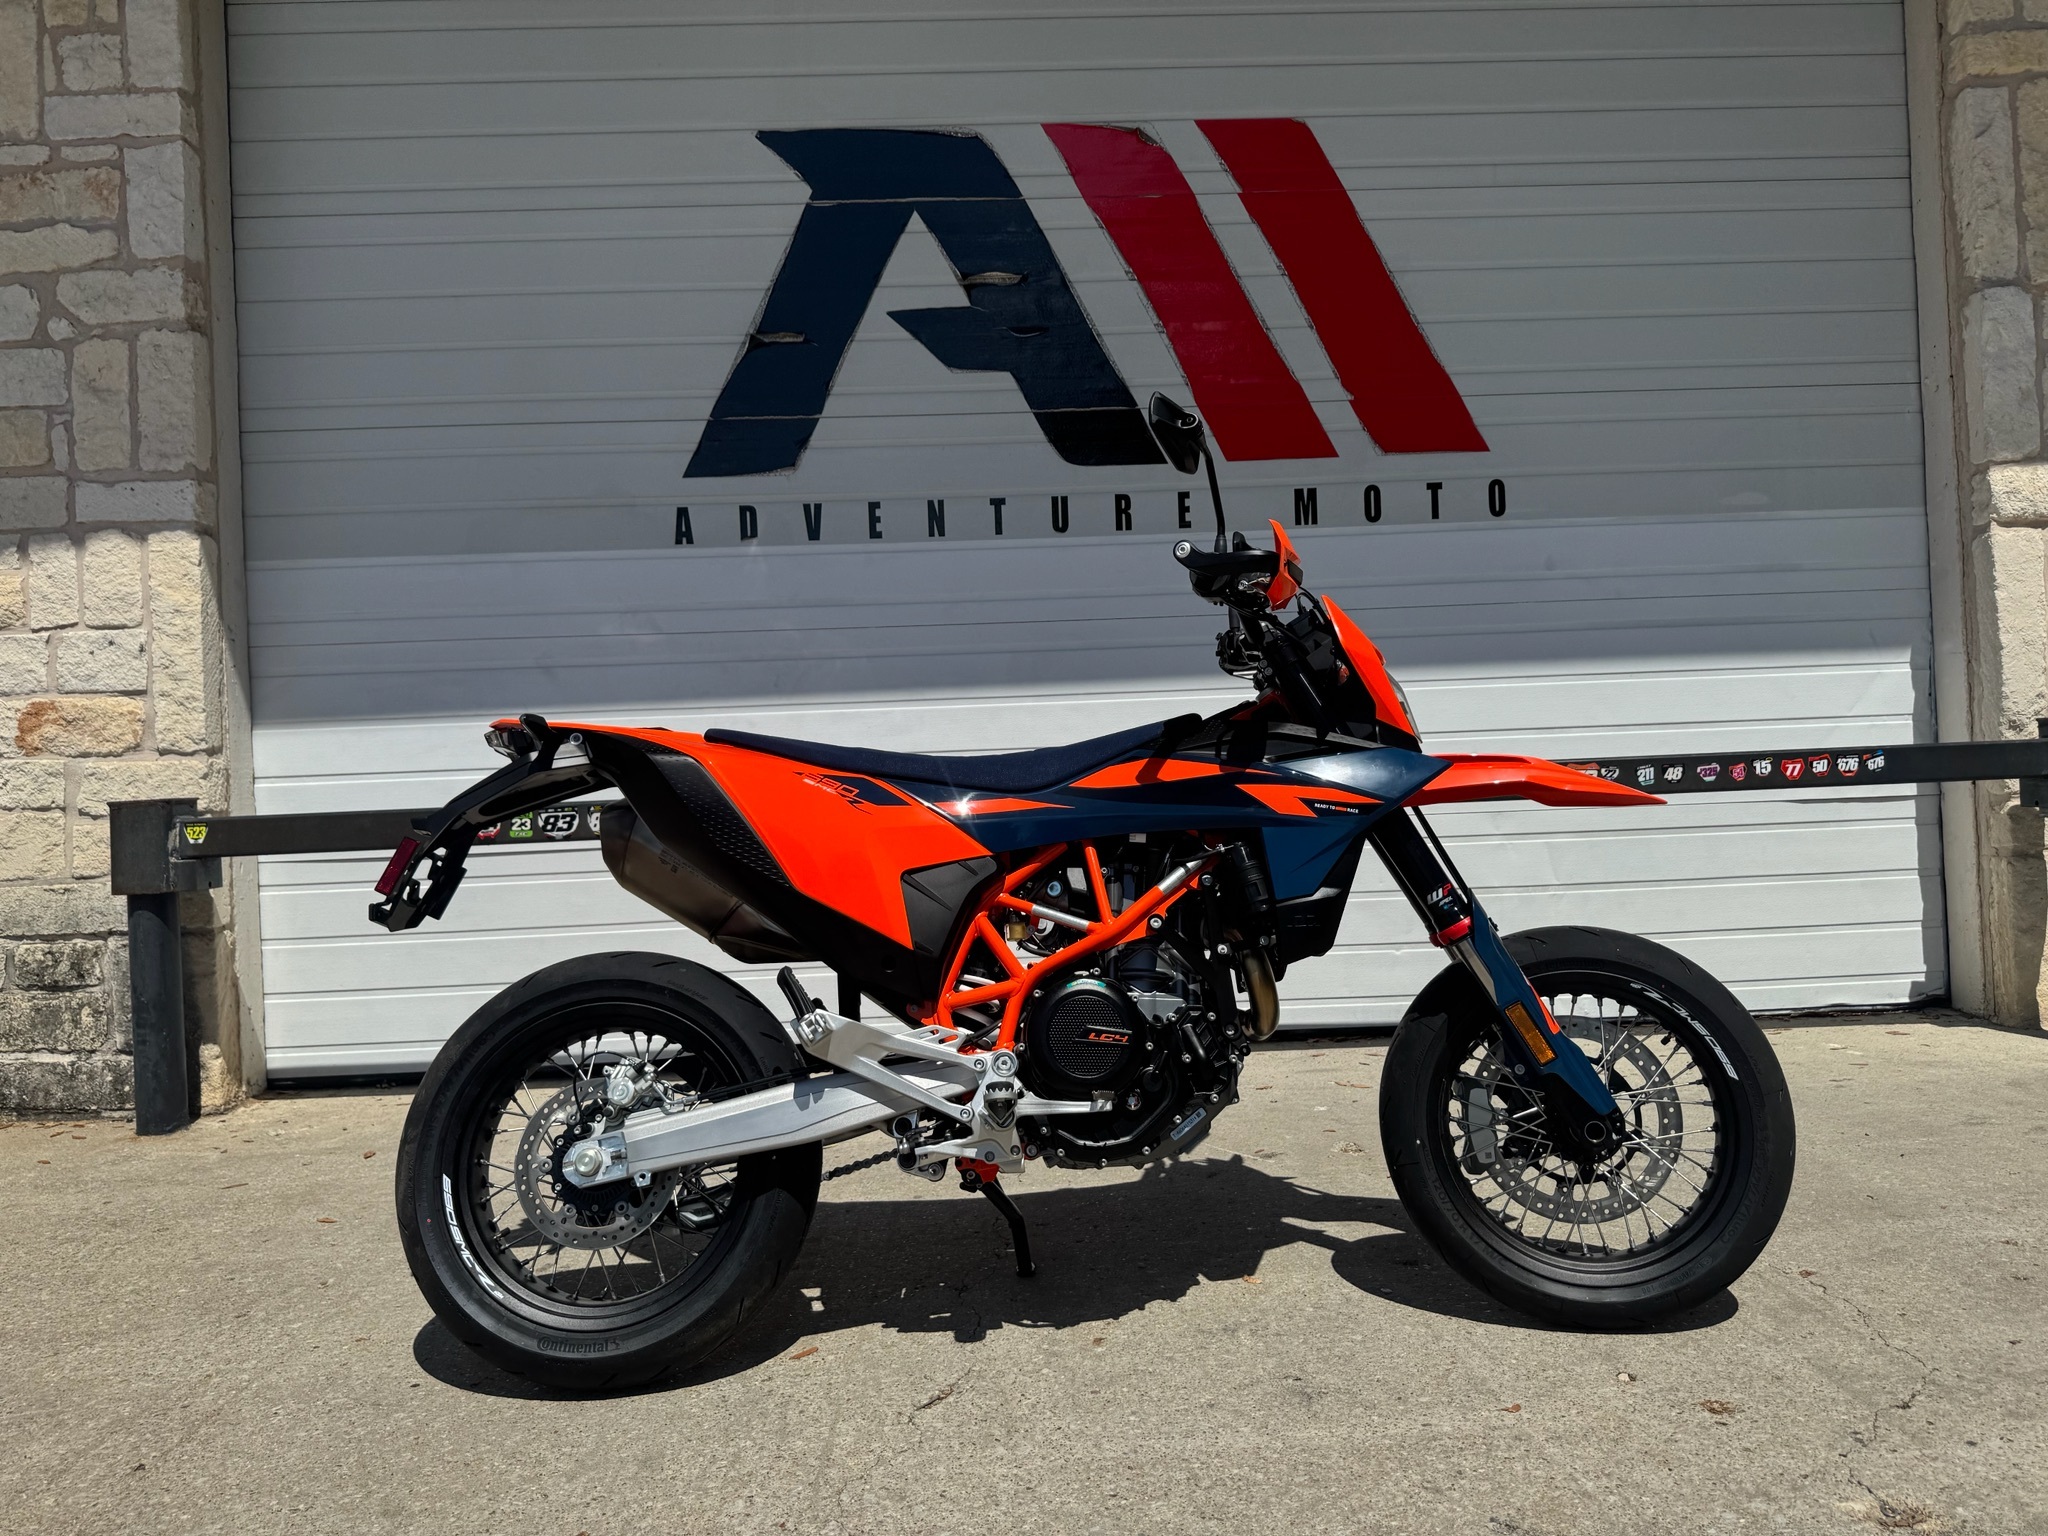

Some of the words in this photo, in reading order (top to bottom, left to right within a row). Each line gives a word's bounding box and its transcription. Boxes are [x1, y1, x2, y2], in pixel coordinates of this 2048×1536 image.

[674, 490, 1192, 545] ADVENTURE
[1293, 478, 1507, 526] MOTO
[1664, 766, 1683, 781] 48
[1753, 759, 1772, 776] 15
[1785, 763, 1801, 777] 77
[1812, 759, 1828, 773] 50
[1637, 767, 1654, 782] 211
[511, 818, 532, 831] 23
[541, 813, 578, 833] 83
[186, 826, 206, 839] 523
[1426, 882, 1452, 905] WP
[1088, 1032, 1129, 1043] LC4
[537, 1336, 609, 1354] Continental
